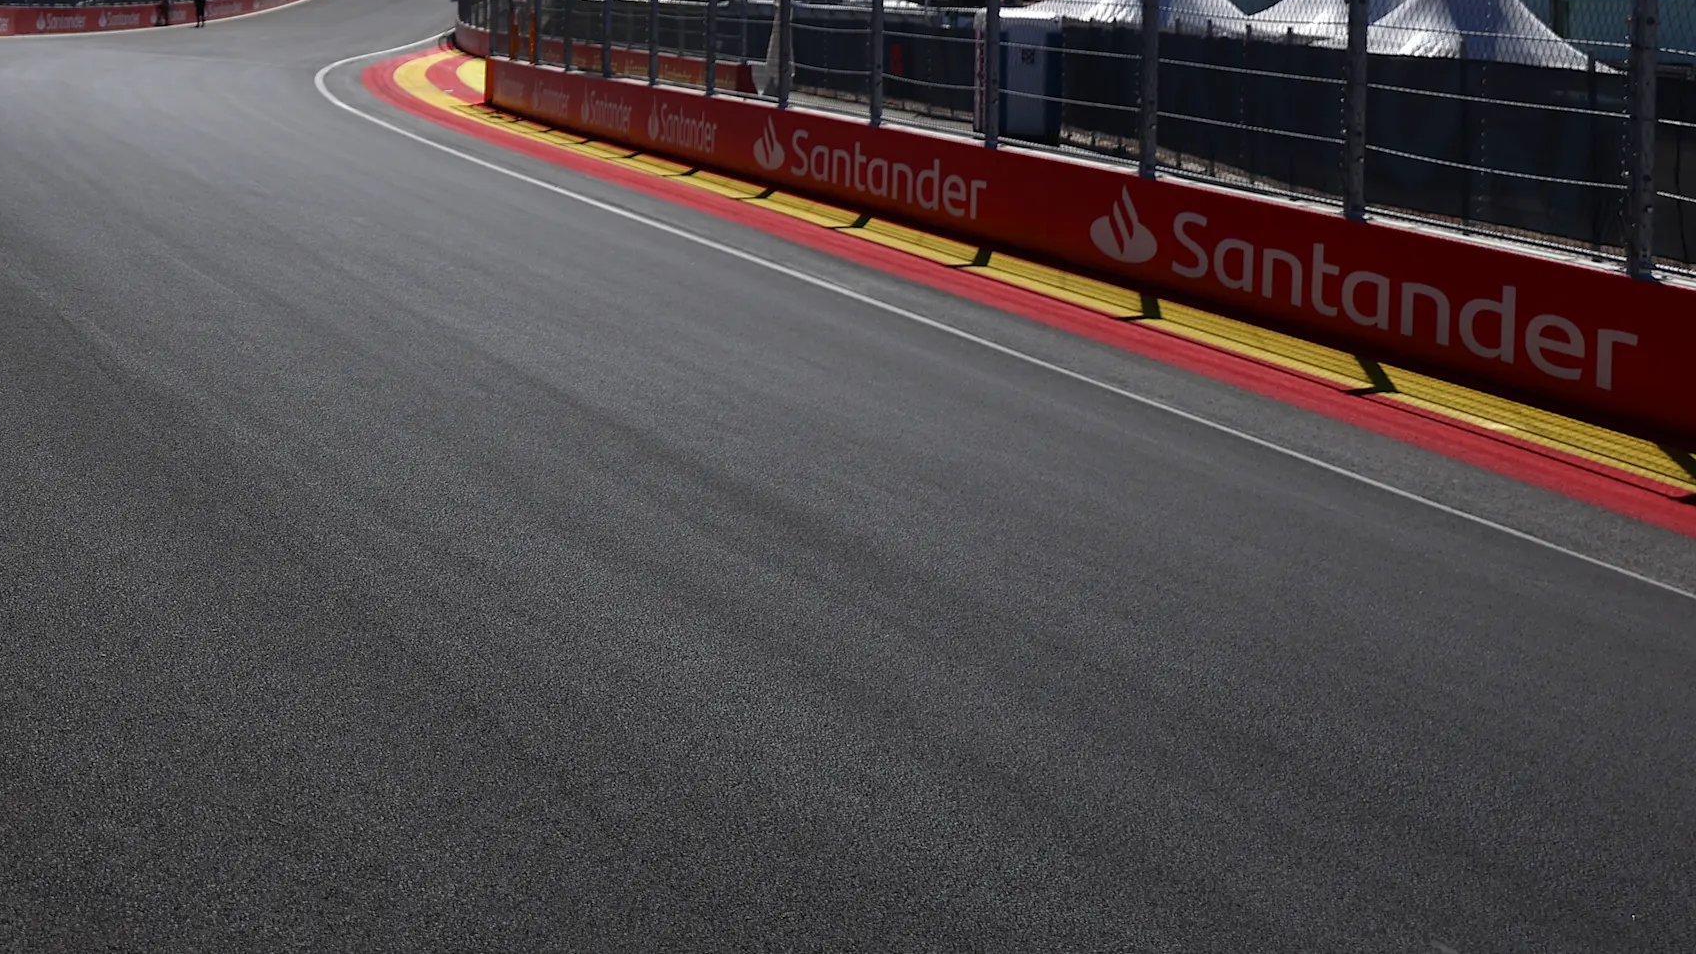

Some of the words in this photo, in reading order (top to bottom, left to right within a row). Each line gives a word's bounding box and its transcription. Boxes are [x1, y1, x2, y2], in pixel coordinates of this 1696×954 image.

[44, 12, 86, 29] Santander
[106, 11, 140, 28] Santander
[590, 90, 632, 133] Santander
[660, 103, 717, 153] Santander
[791, 128, 987, 220] Santander
[1172, 211, 1638, 390] Santander
